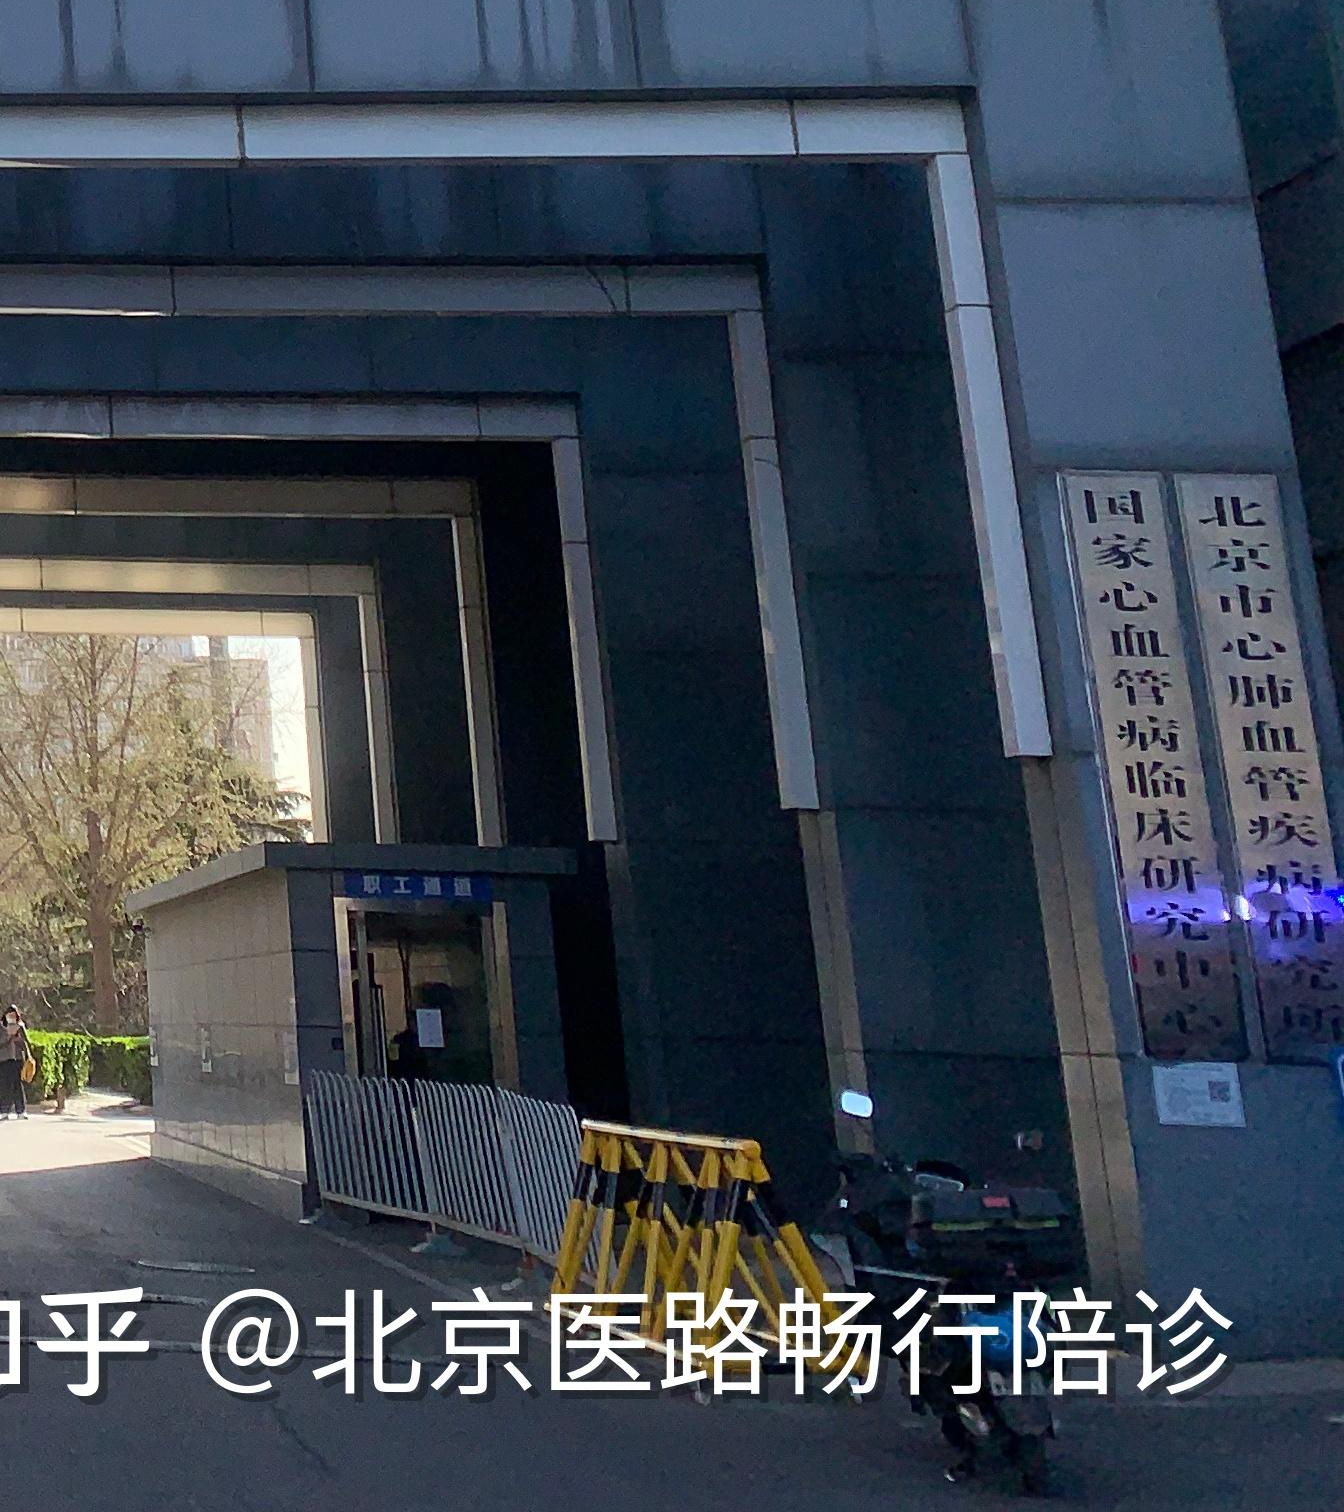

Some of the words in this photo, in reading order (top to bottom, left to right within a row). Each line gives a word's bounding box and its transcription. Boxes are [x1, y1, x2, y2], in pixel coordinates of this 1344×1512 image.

[1083, 489, 1222, 1036] 国家心血管病临床研究中心
[1198, 495, 1343, 1044] 北京市心肺血管疾病研究所
